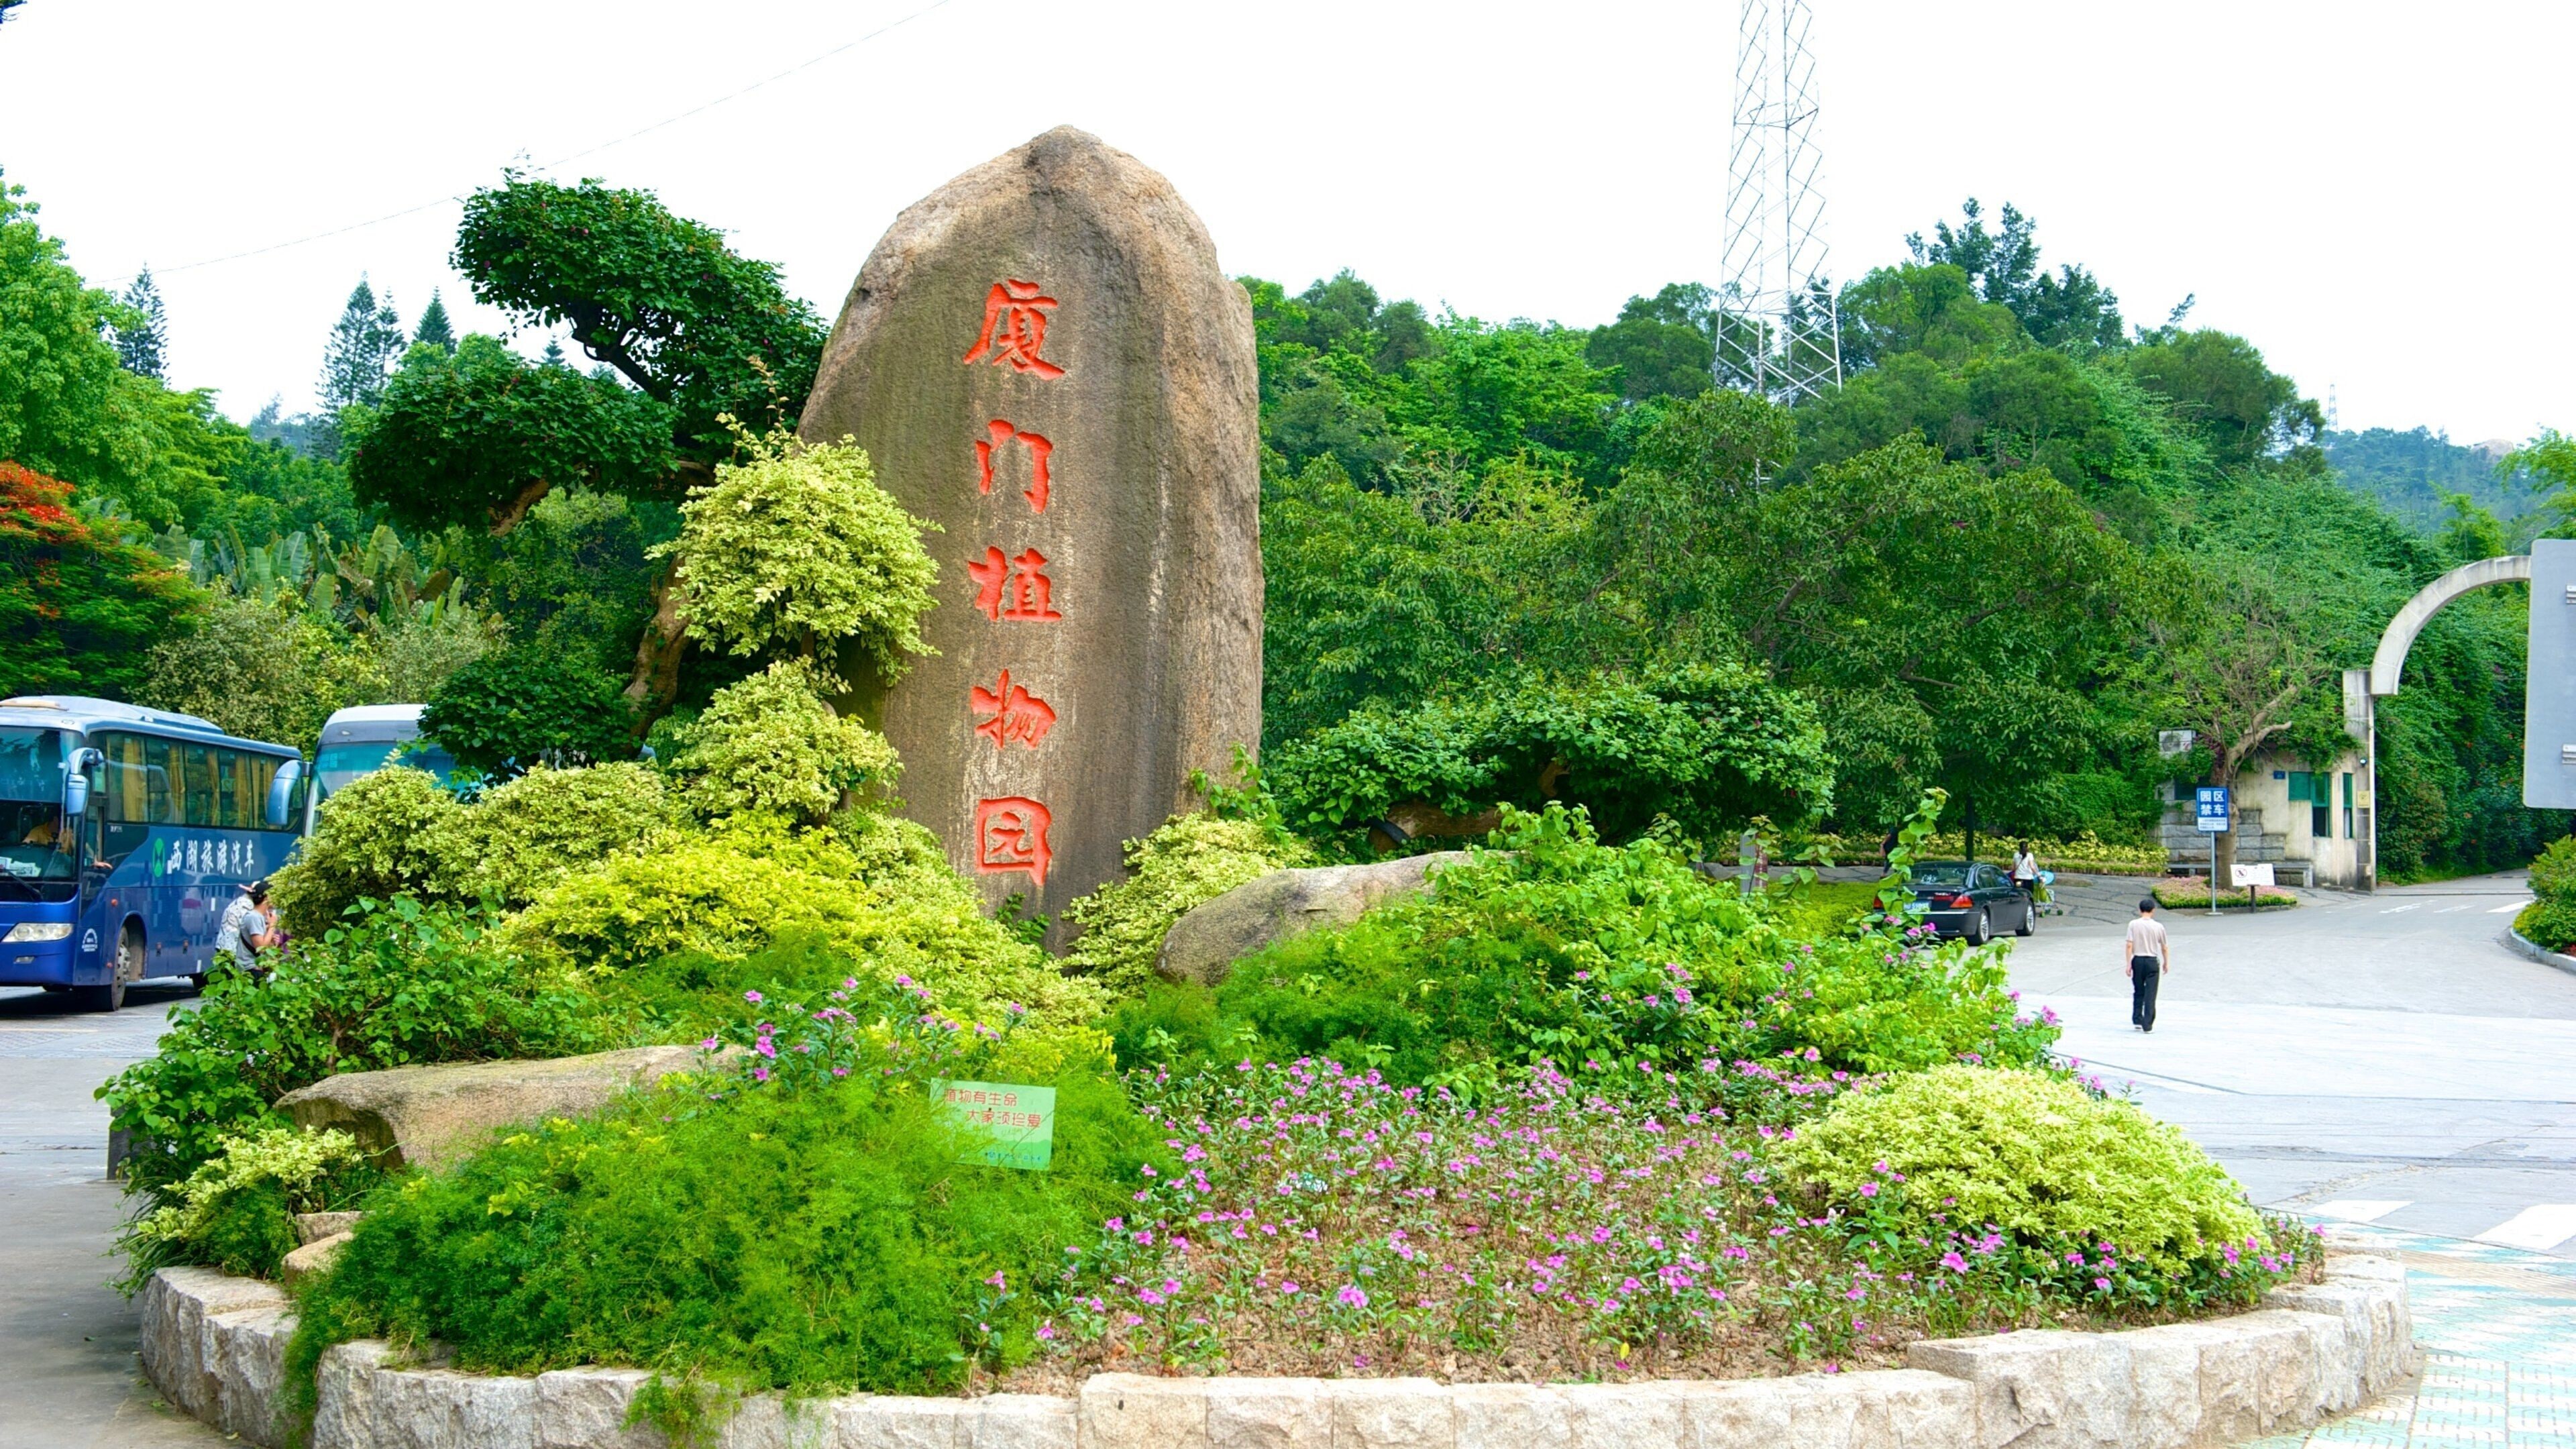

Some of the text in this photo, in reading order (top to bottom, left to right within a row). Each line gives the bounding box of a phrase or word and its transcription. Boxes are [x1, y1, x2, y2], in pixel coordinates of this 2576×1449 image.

[963, 277, 1065, 885] 厦门植物园
[2200, 804, 2224, 815] 禁车
[171, 839, 254, 876] 西湖旅游汽车
[945, 1089, 1017, 1106] 植物有生命
[966, 1109, 1041, 1128] 大家须珍爱
